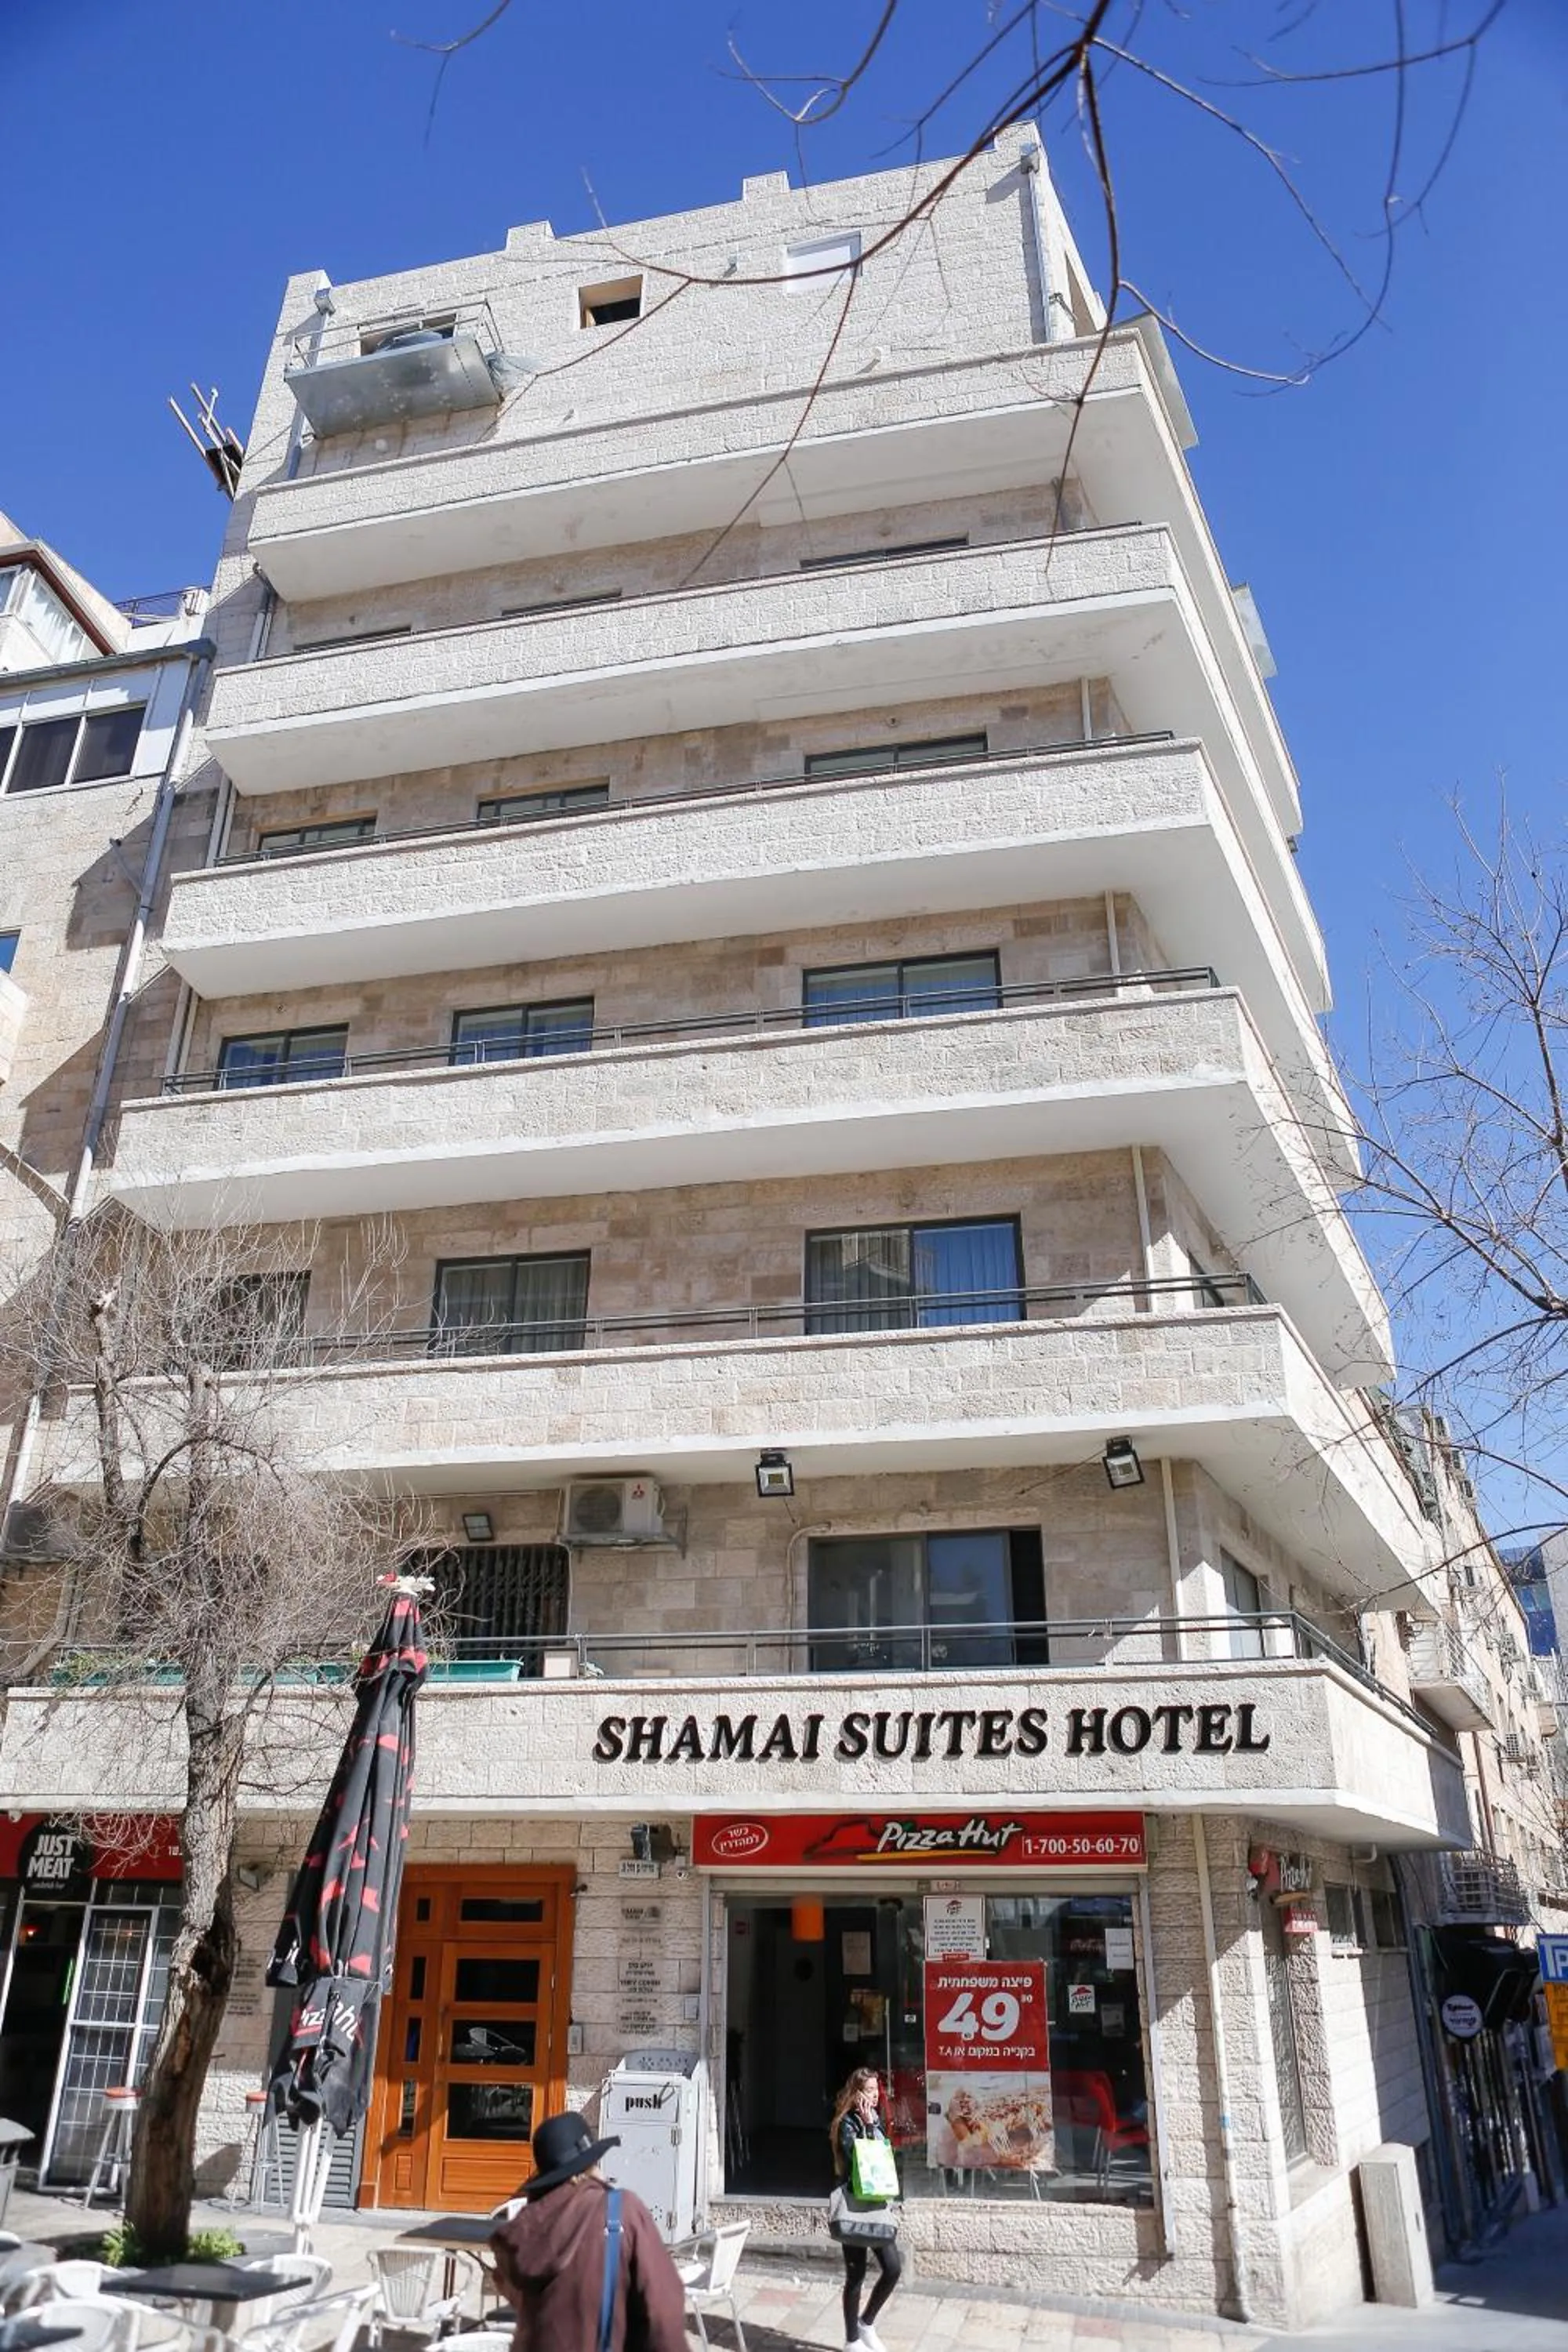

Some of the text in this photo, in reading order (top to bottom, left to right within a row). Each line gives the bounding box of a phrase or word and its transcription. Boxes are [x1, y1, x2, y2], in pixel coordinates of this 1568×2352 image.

[593, 1703, 1270, 1761] SHAMAI SUITES HOTEL
[34, 1834, 78, 1856] JUST
[877, 1818, 1023, 1853] Pizza Hut
[1025, 1837, 1139, 1855] 1-700-50-60-70
[27, 1856, 75, 1878] MEAT
[937, 1976, 1033, 1989] פיצה משפחתית
[937, 1991, 1020, 2042] 49
[968, 2046, 1000, 2060] במקום
[625, 2093, 662, 2113] push
